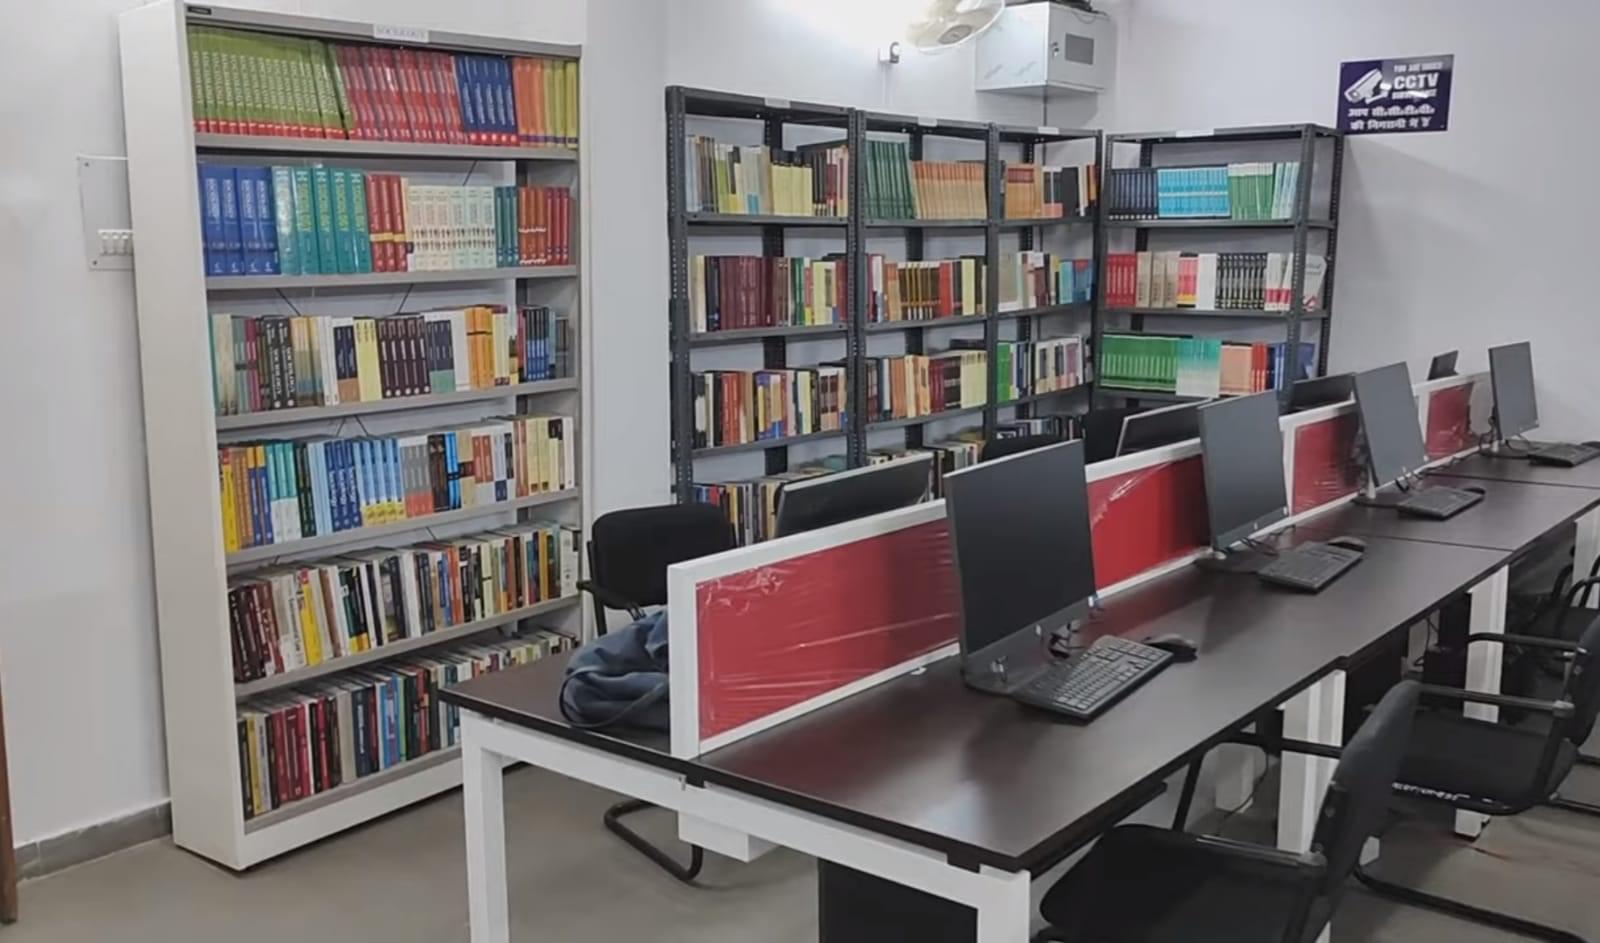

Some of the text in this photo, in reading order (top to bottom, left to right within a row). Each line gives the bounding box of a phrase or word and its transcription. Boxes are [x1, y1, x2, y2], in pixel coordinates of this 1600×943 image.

[1394, 73, 1439, 89] CCTV
[298, 183, 312, 232] SOCIOLOGY
[319, 184, 331, 232] SOCIOLOGY
[336, 183, 349, 232] SOCIOLOGY
[352, 184, 364, 232] SOCIOLOGY
